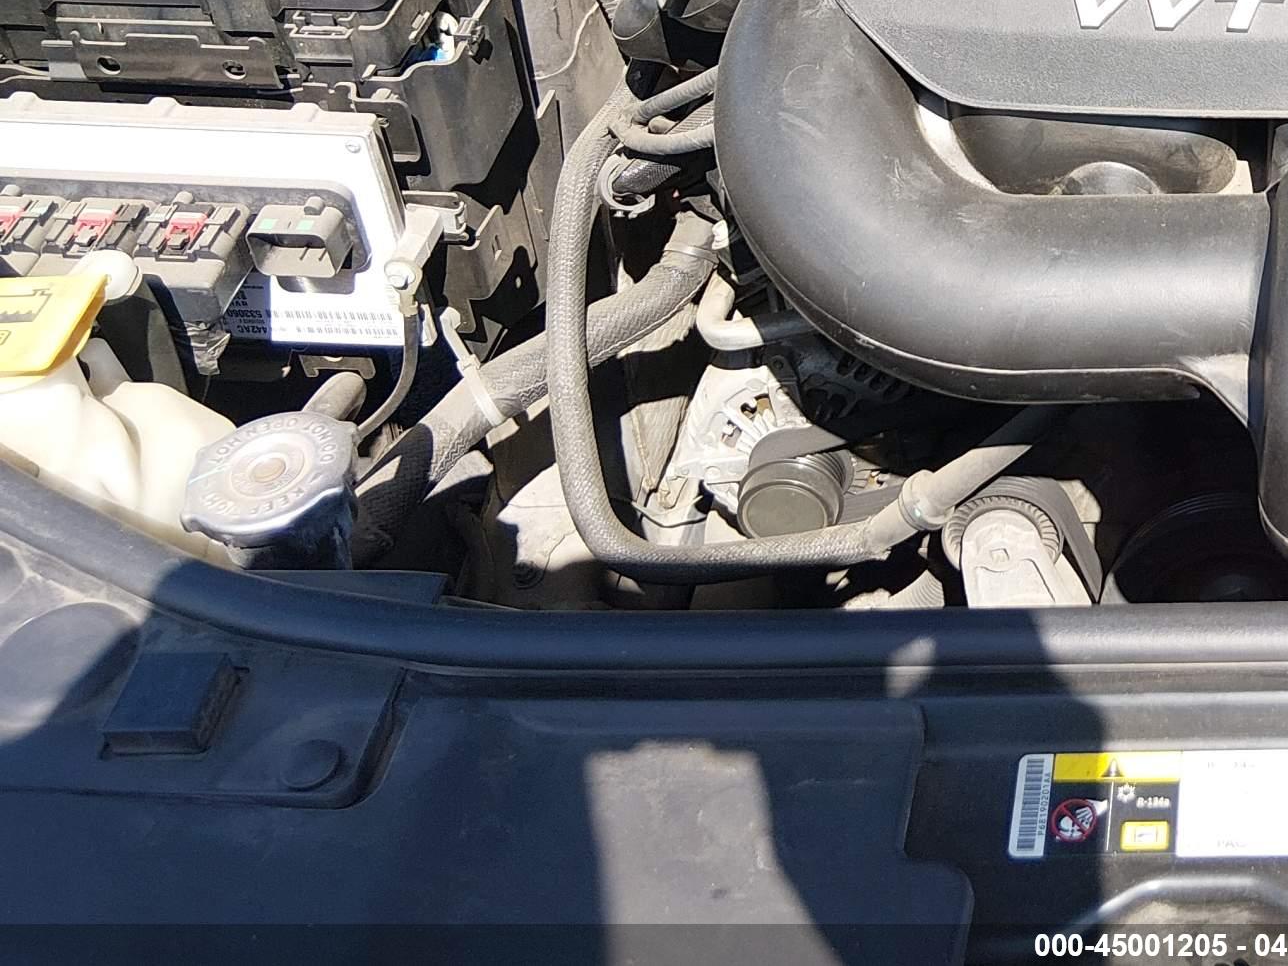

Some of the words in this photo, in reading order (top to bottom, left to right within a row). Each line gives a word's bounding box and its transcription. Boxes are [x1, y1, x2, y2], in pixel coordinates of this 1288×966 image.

[245, 416, 299, 438] OPEN
[302, 420, 332, 442] NOT
[207, 436, 243, 466] HOT
[247, 486, 306, 515] KEEP
